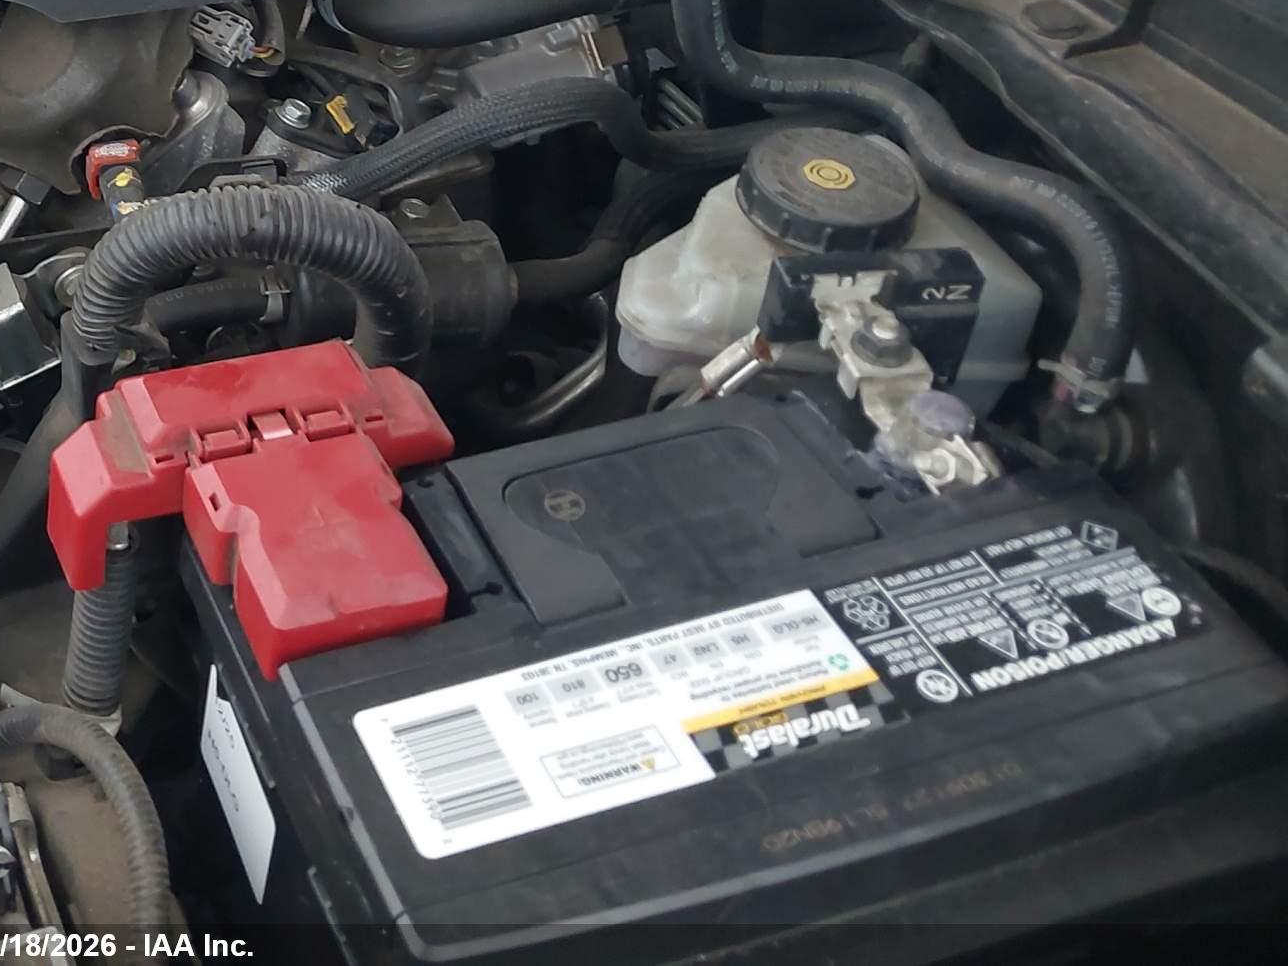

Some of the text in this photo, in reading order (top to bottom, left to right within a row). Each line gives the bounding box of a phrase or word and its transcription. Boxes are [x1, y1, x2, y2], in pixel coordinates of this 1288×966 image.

[660, 652, 680, 666] 47
[968, 622, 1162, 691] DANGER/POISON
[601, 660, 645, 684] 650
[559, 677, 587, 694] 810
[513, 690, 541, 706] 100
[735, 702, 872, 759] Duralast
[574, 760, 644, 788] WARNING:
